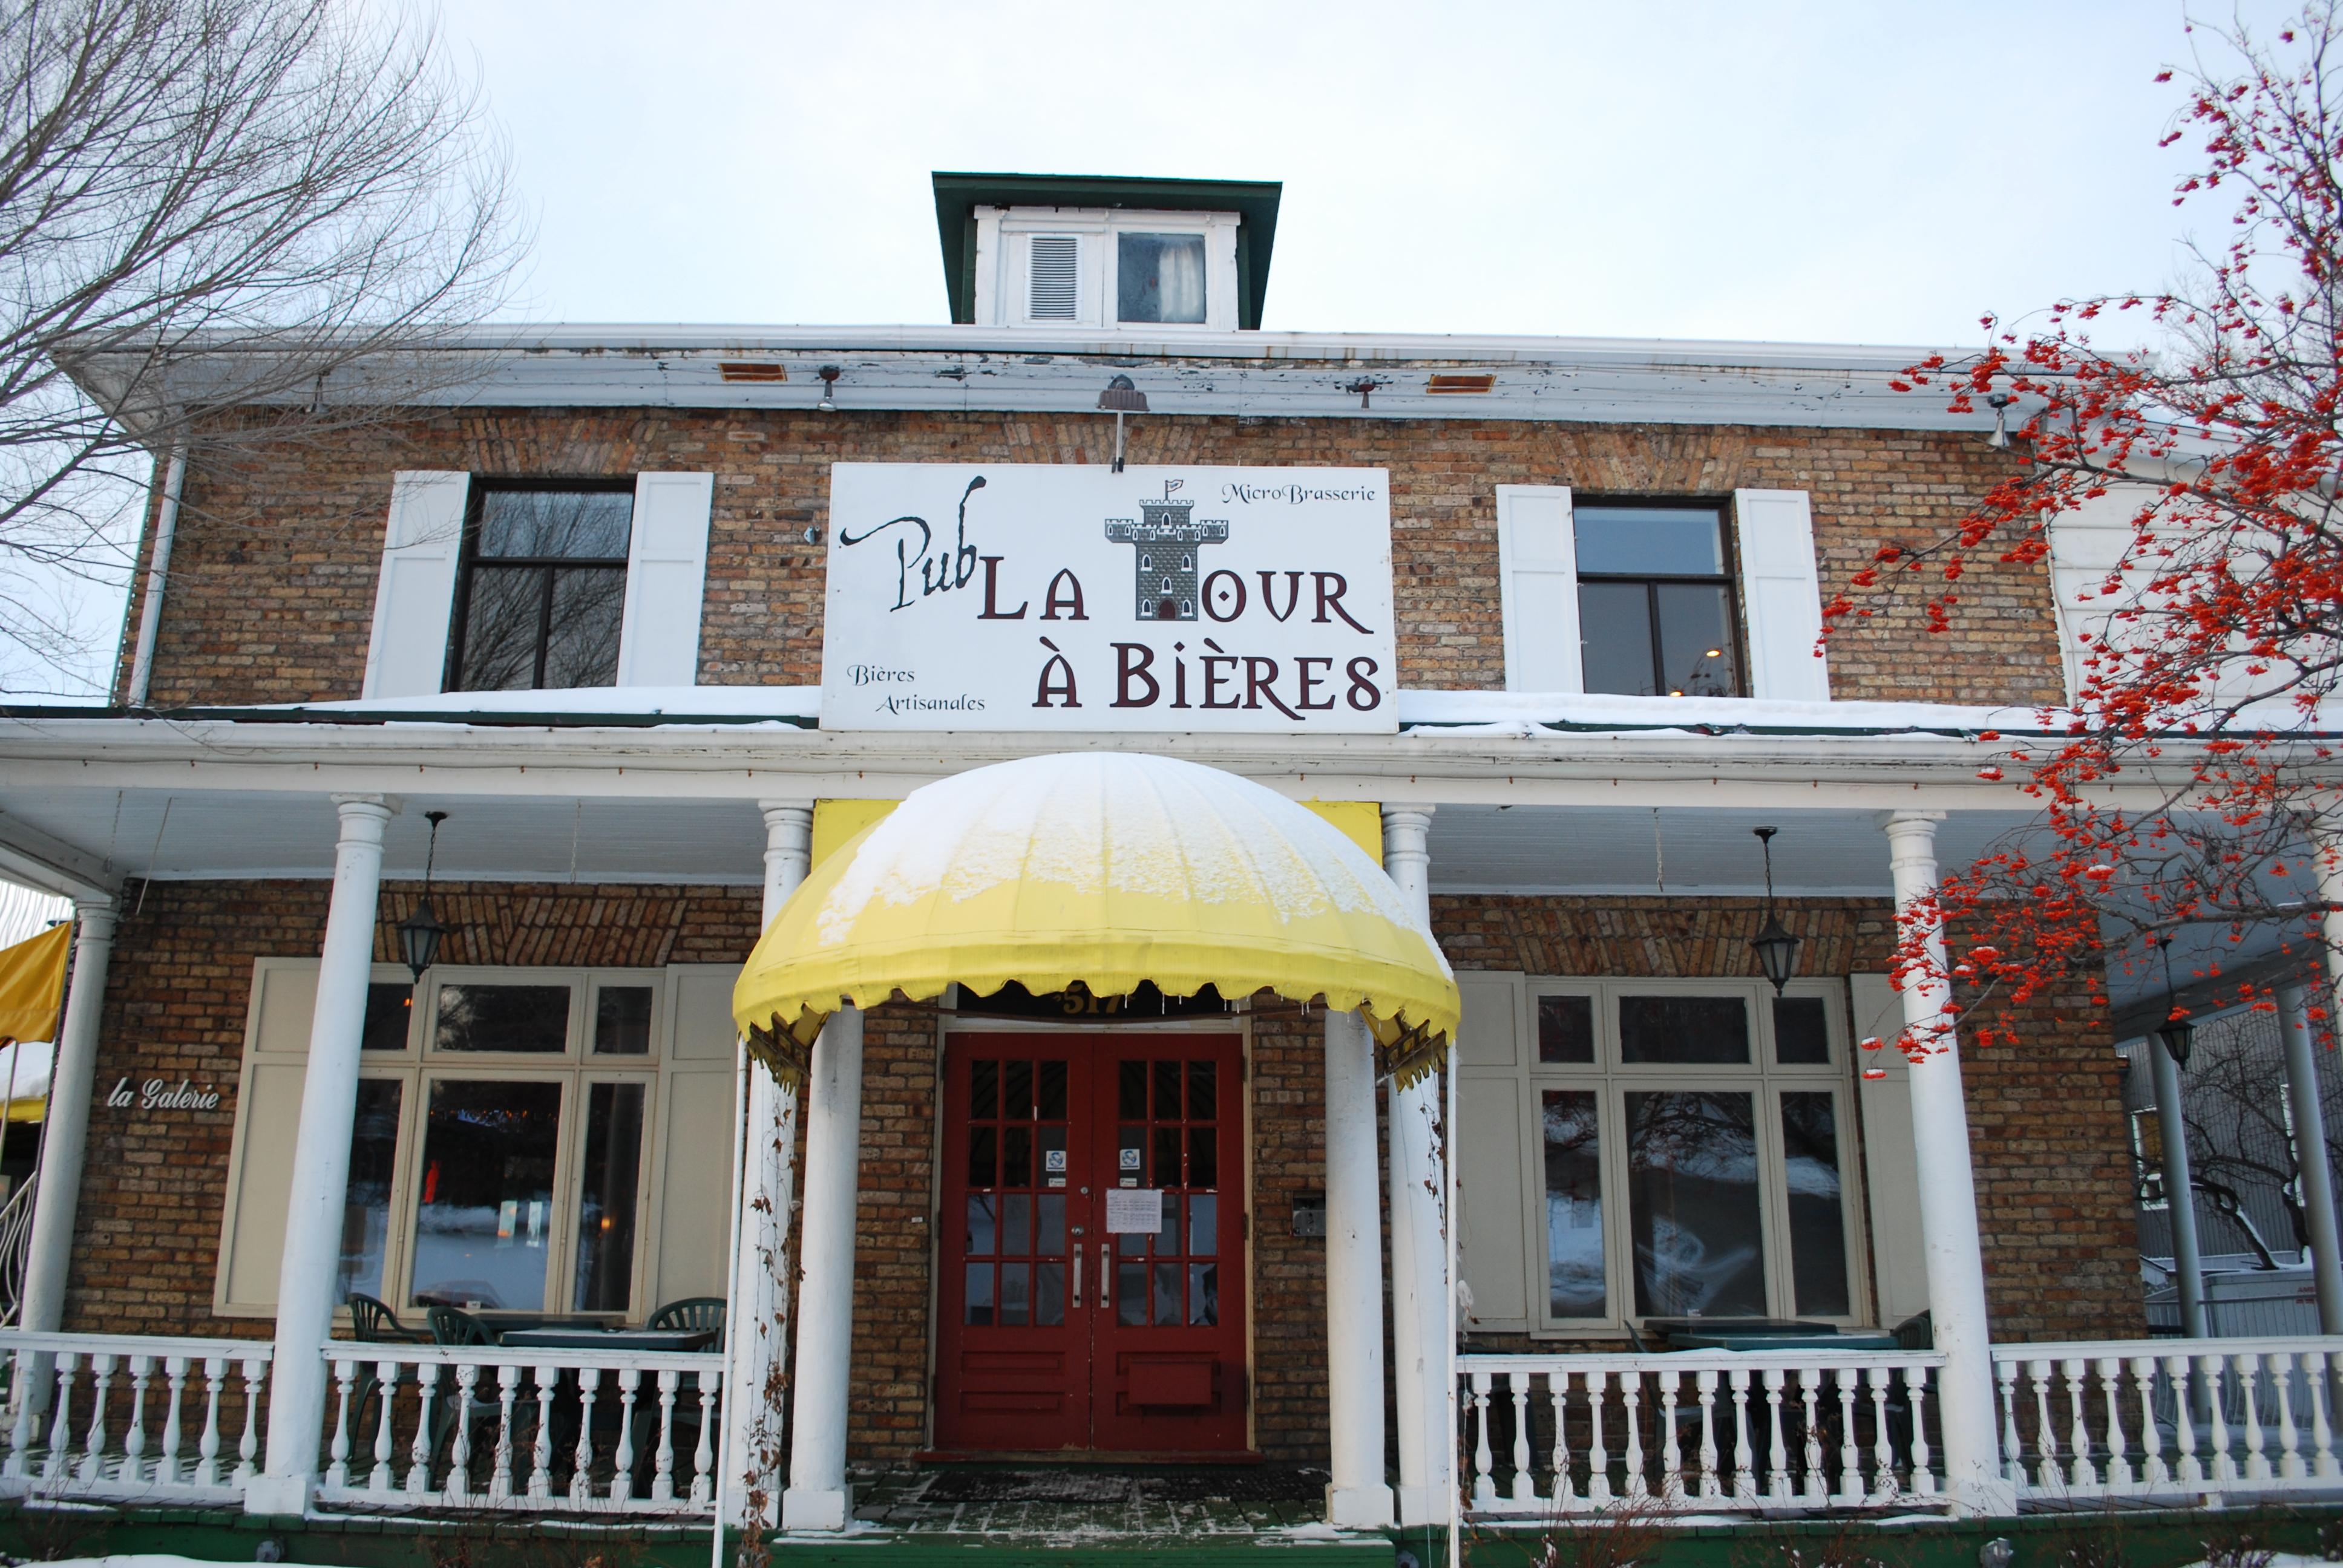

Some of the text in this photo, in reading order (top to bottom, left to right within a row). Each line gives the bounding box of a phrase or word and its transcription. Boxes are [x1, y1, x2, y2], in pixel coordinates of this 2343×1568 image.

[839, 475, 987, 613] Pub
[977, 555, 1090, 621] LA
[847, 665, 915, 686] Bières
[1032, 636, 1083, 708] À
[875, 694, 985, 715] Artisanales
[107, 1077, 220, 1109] la Galerie
